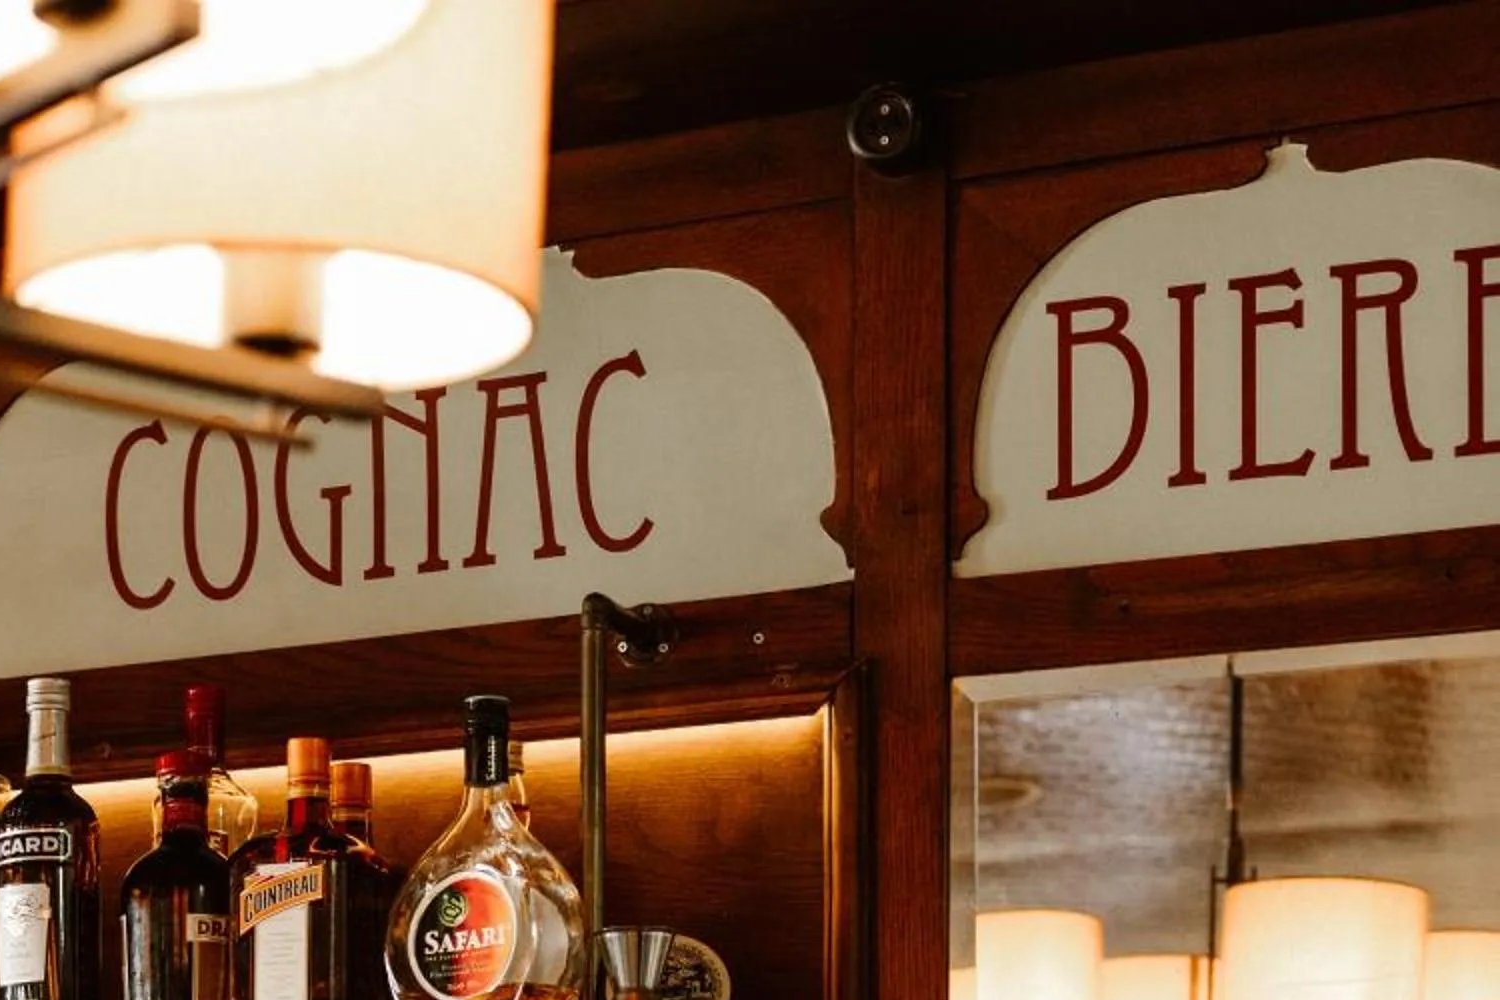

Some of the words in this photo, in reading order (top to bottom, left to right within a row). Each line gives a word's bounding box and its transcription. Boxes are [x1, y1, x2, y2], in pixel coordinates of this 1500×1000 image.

[1046, 244, 1500, 500] BIERE
[105, 349, 654, 610] COGNAC
[244, 872, 319, 924] COINTREAU
[424, 924, 506, 956] SAFARI
